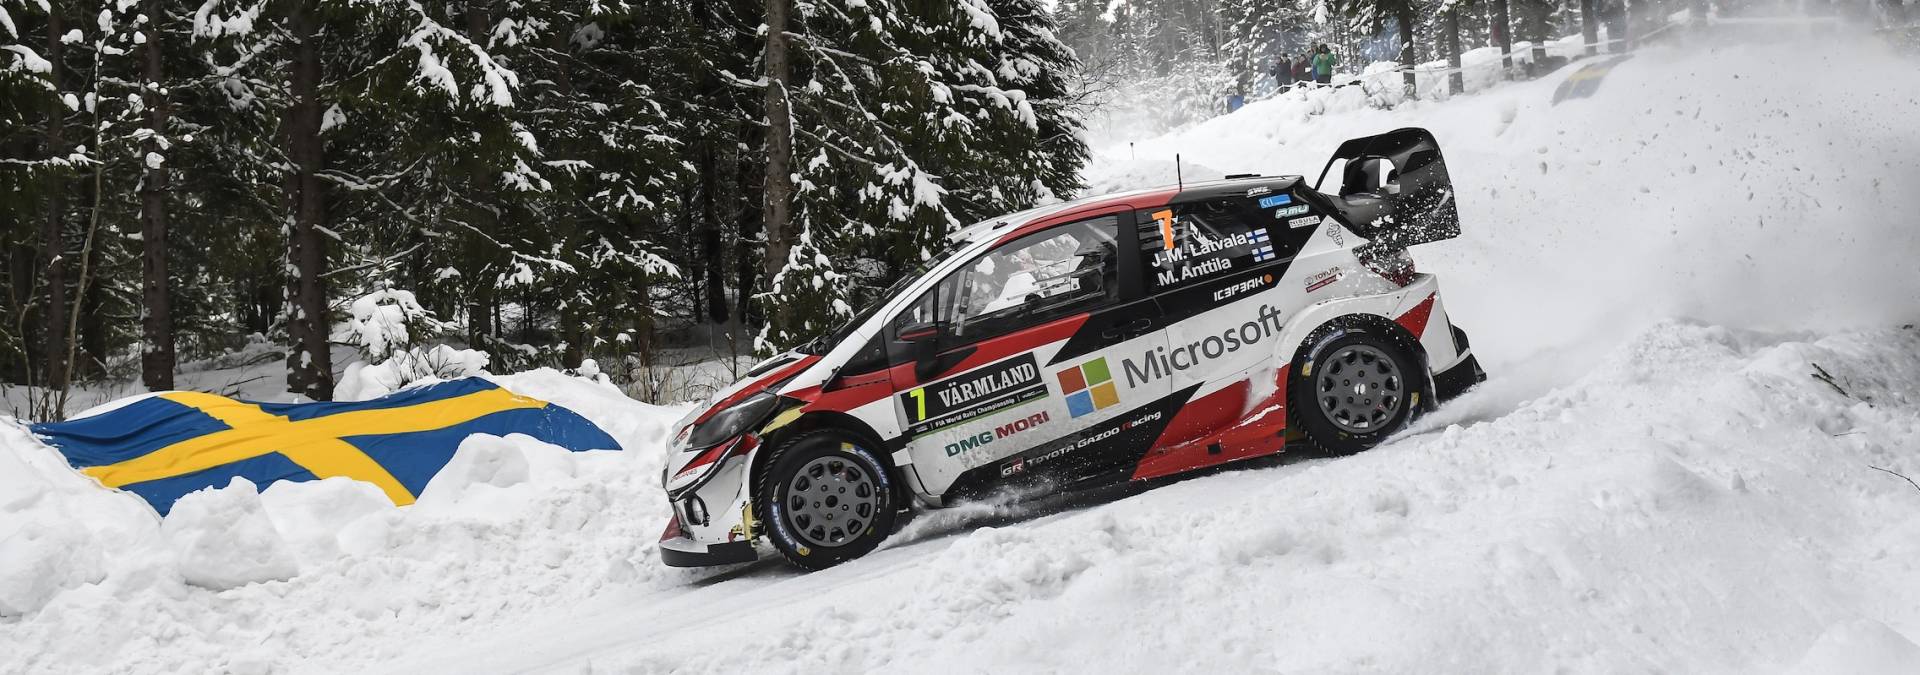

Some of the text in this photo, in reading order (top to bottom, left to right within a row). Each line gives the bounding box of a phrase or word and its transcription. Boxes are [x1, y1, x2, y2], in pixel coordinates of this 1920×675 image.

[1151, 209, 1175, 250] 7
[1151, 233, 1248, 268] J-M. Latvala
[1157, 257, 1232, 287] M. Anttila
[1121, 303, 1284, 389] Microsoft
[909, 362, 1036, 421] 7 VÄRMLAND
[946, 414, 962, 424] World
[977, 398, 1015, 414] Championship
[944, 410, 1050, 458] DMG MORI
[1002, 411, 1162, 477] GR TOYOTA GAZOO Racing
